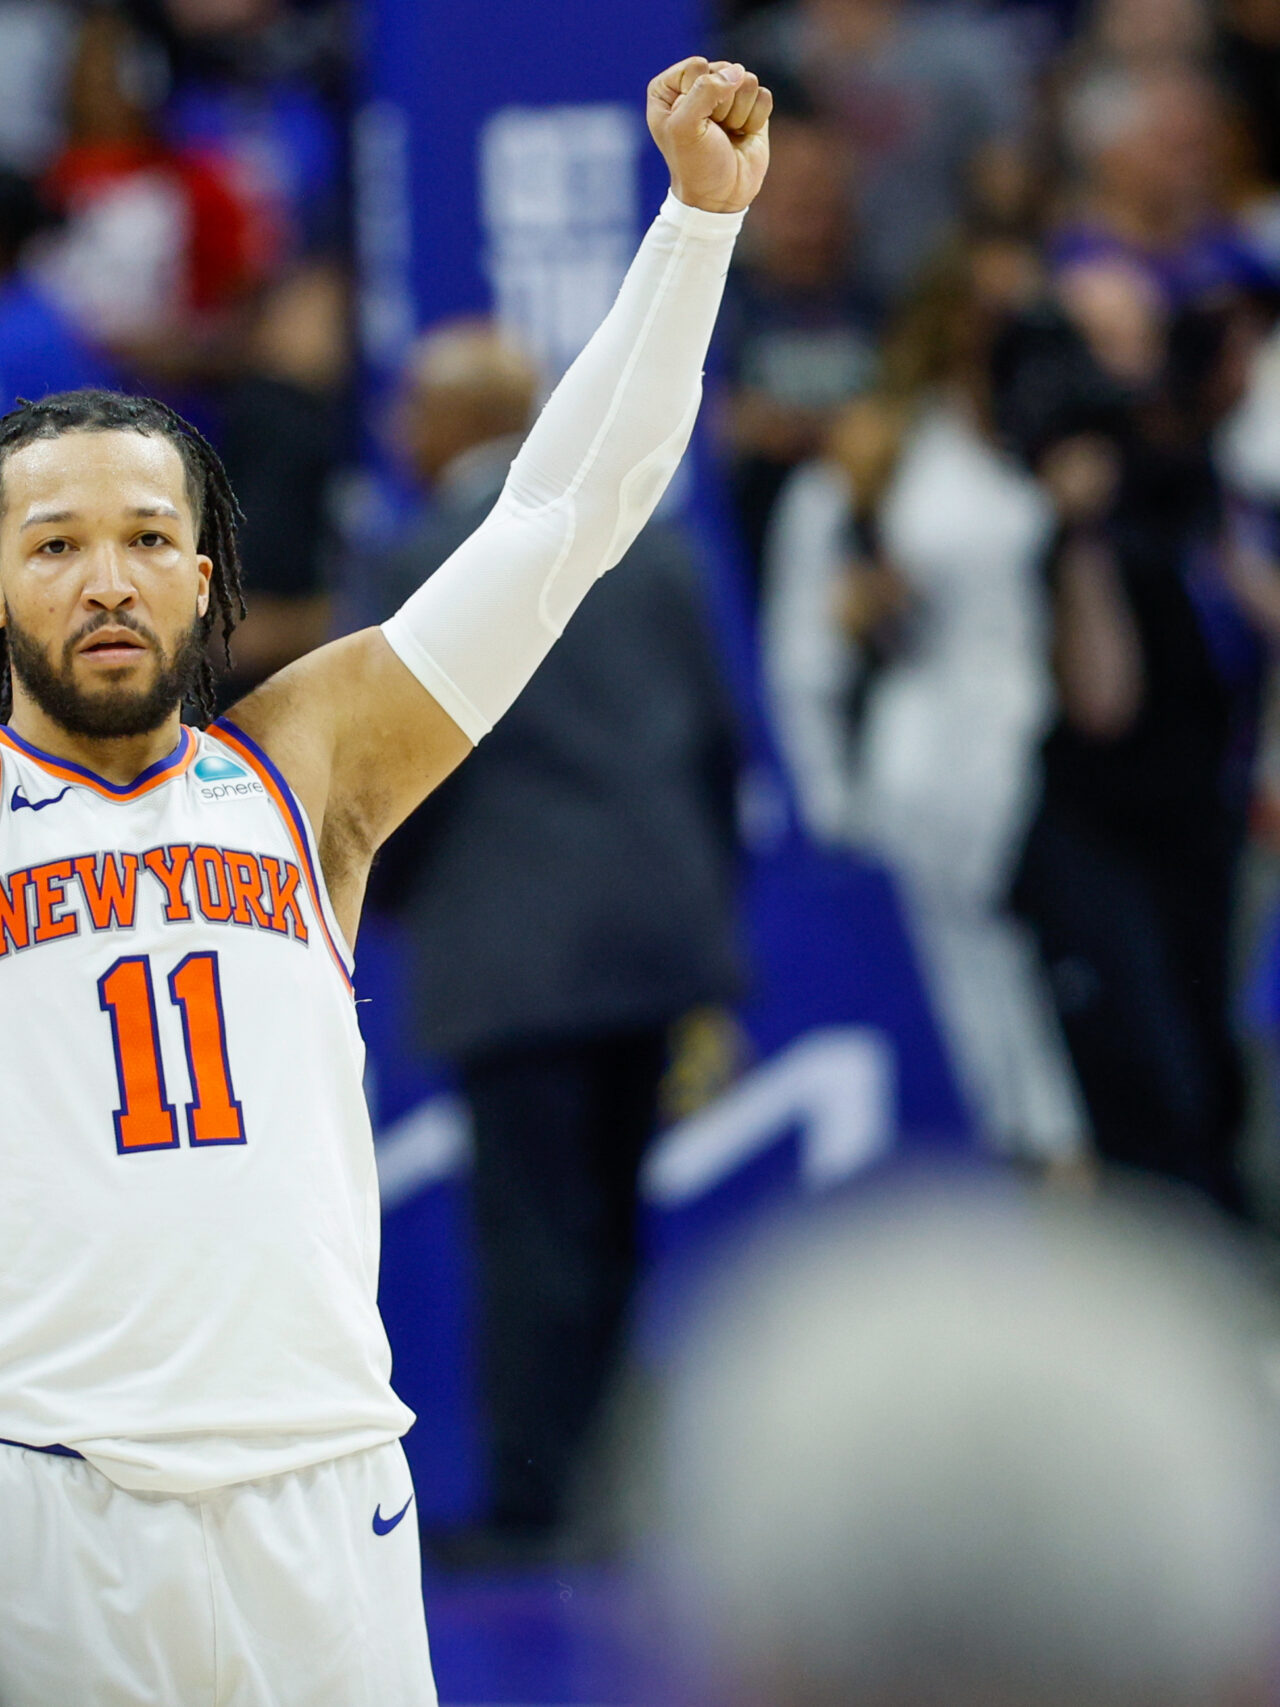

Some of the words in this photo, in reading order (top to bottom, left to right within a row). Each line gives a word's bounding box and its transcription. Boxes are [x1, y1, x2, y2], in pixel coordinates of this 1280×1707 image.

[200, 782, 264, 800] sphere
[141, 843, 309, 948] YORK
[96, 951, 247, 1156] 11
